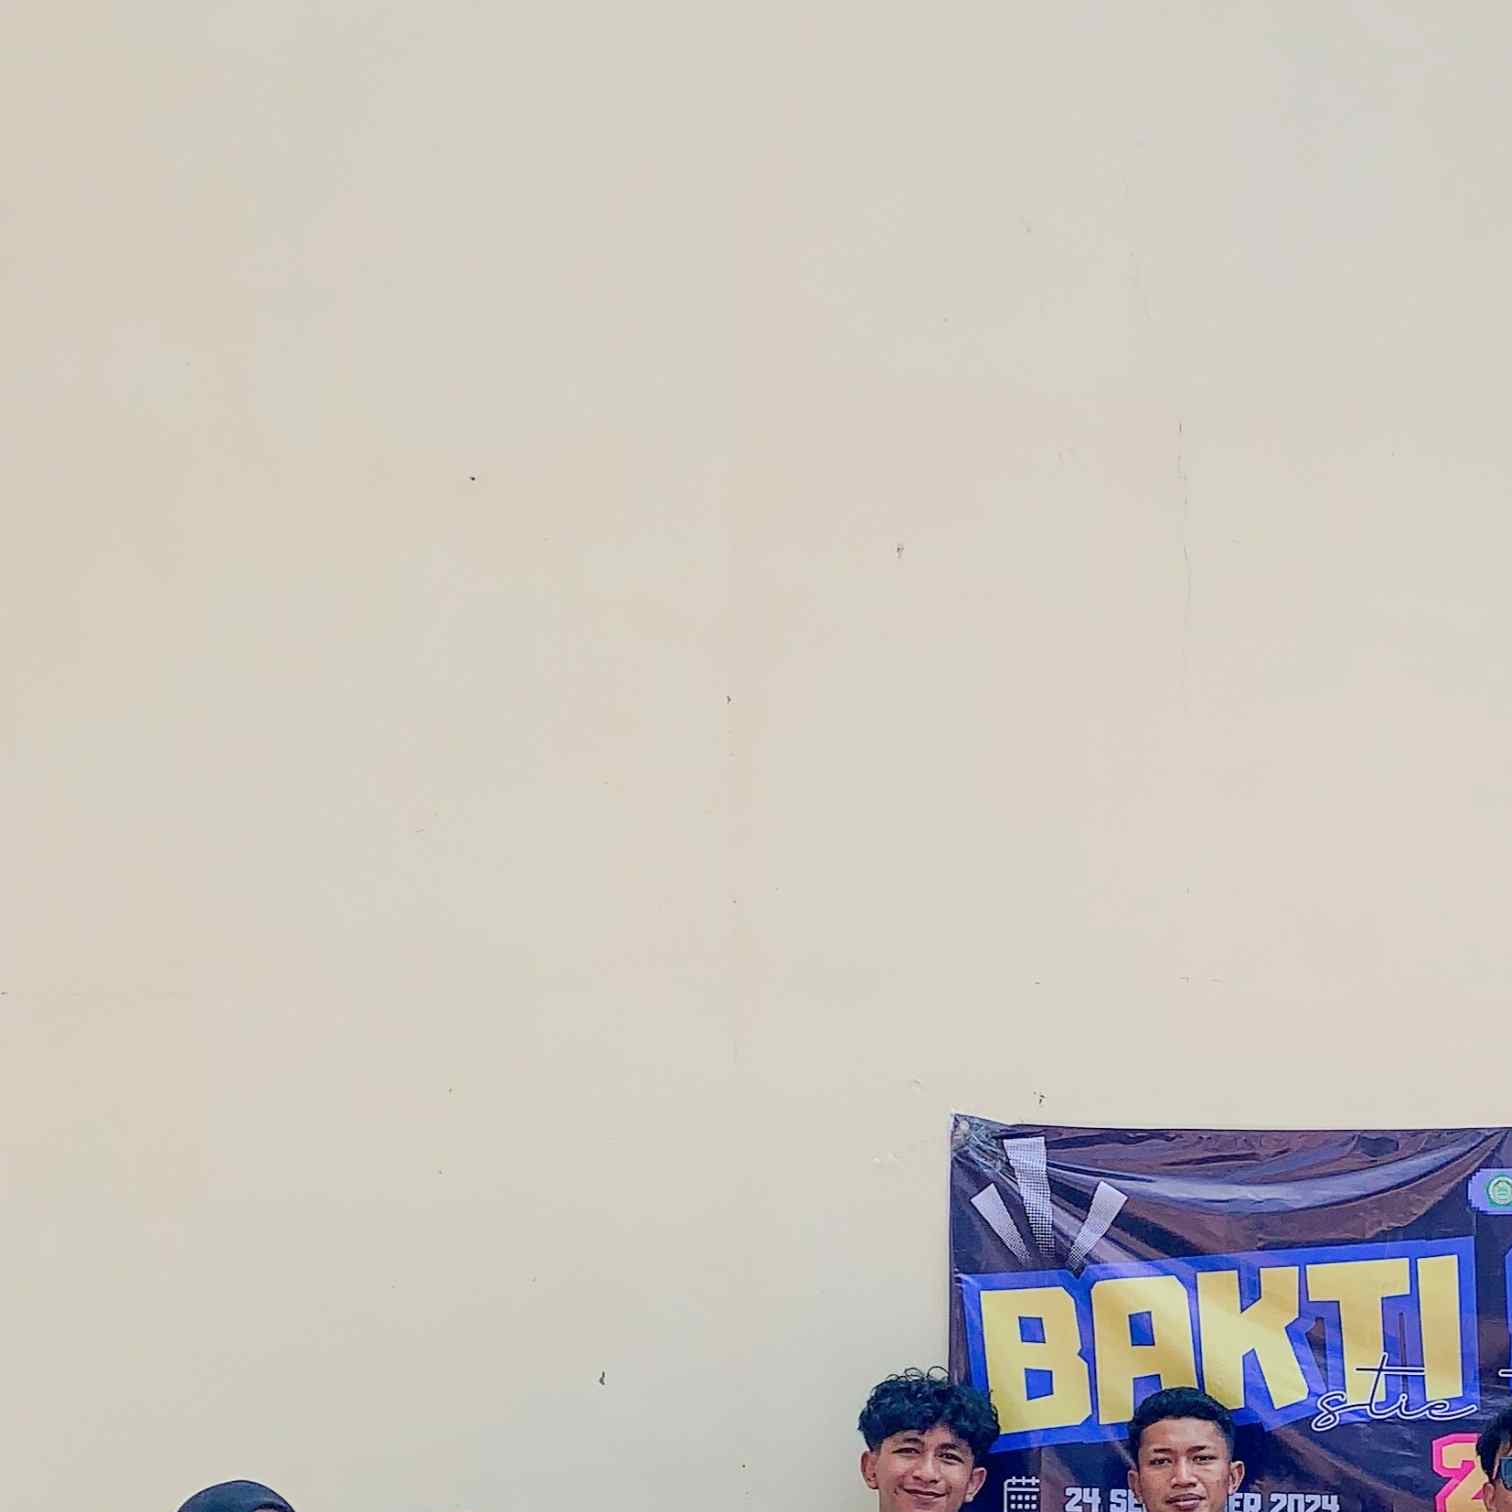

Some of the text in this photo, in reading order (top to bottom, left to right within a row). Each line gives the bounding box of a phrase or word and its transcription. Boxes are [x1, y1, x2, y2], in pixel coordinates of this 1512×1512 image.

[979, 1253, 1465, 1433] BAKTI
[1308, 1350, 1478, 1433] stie
[1065, 1487, 1102, 1512] 24
